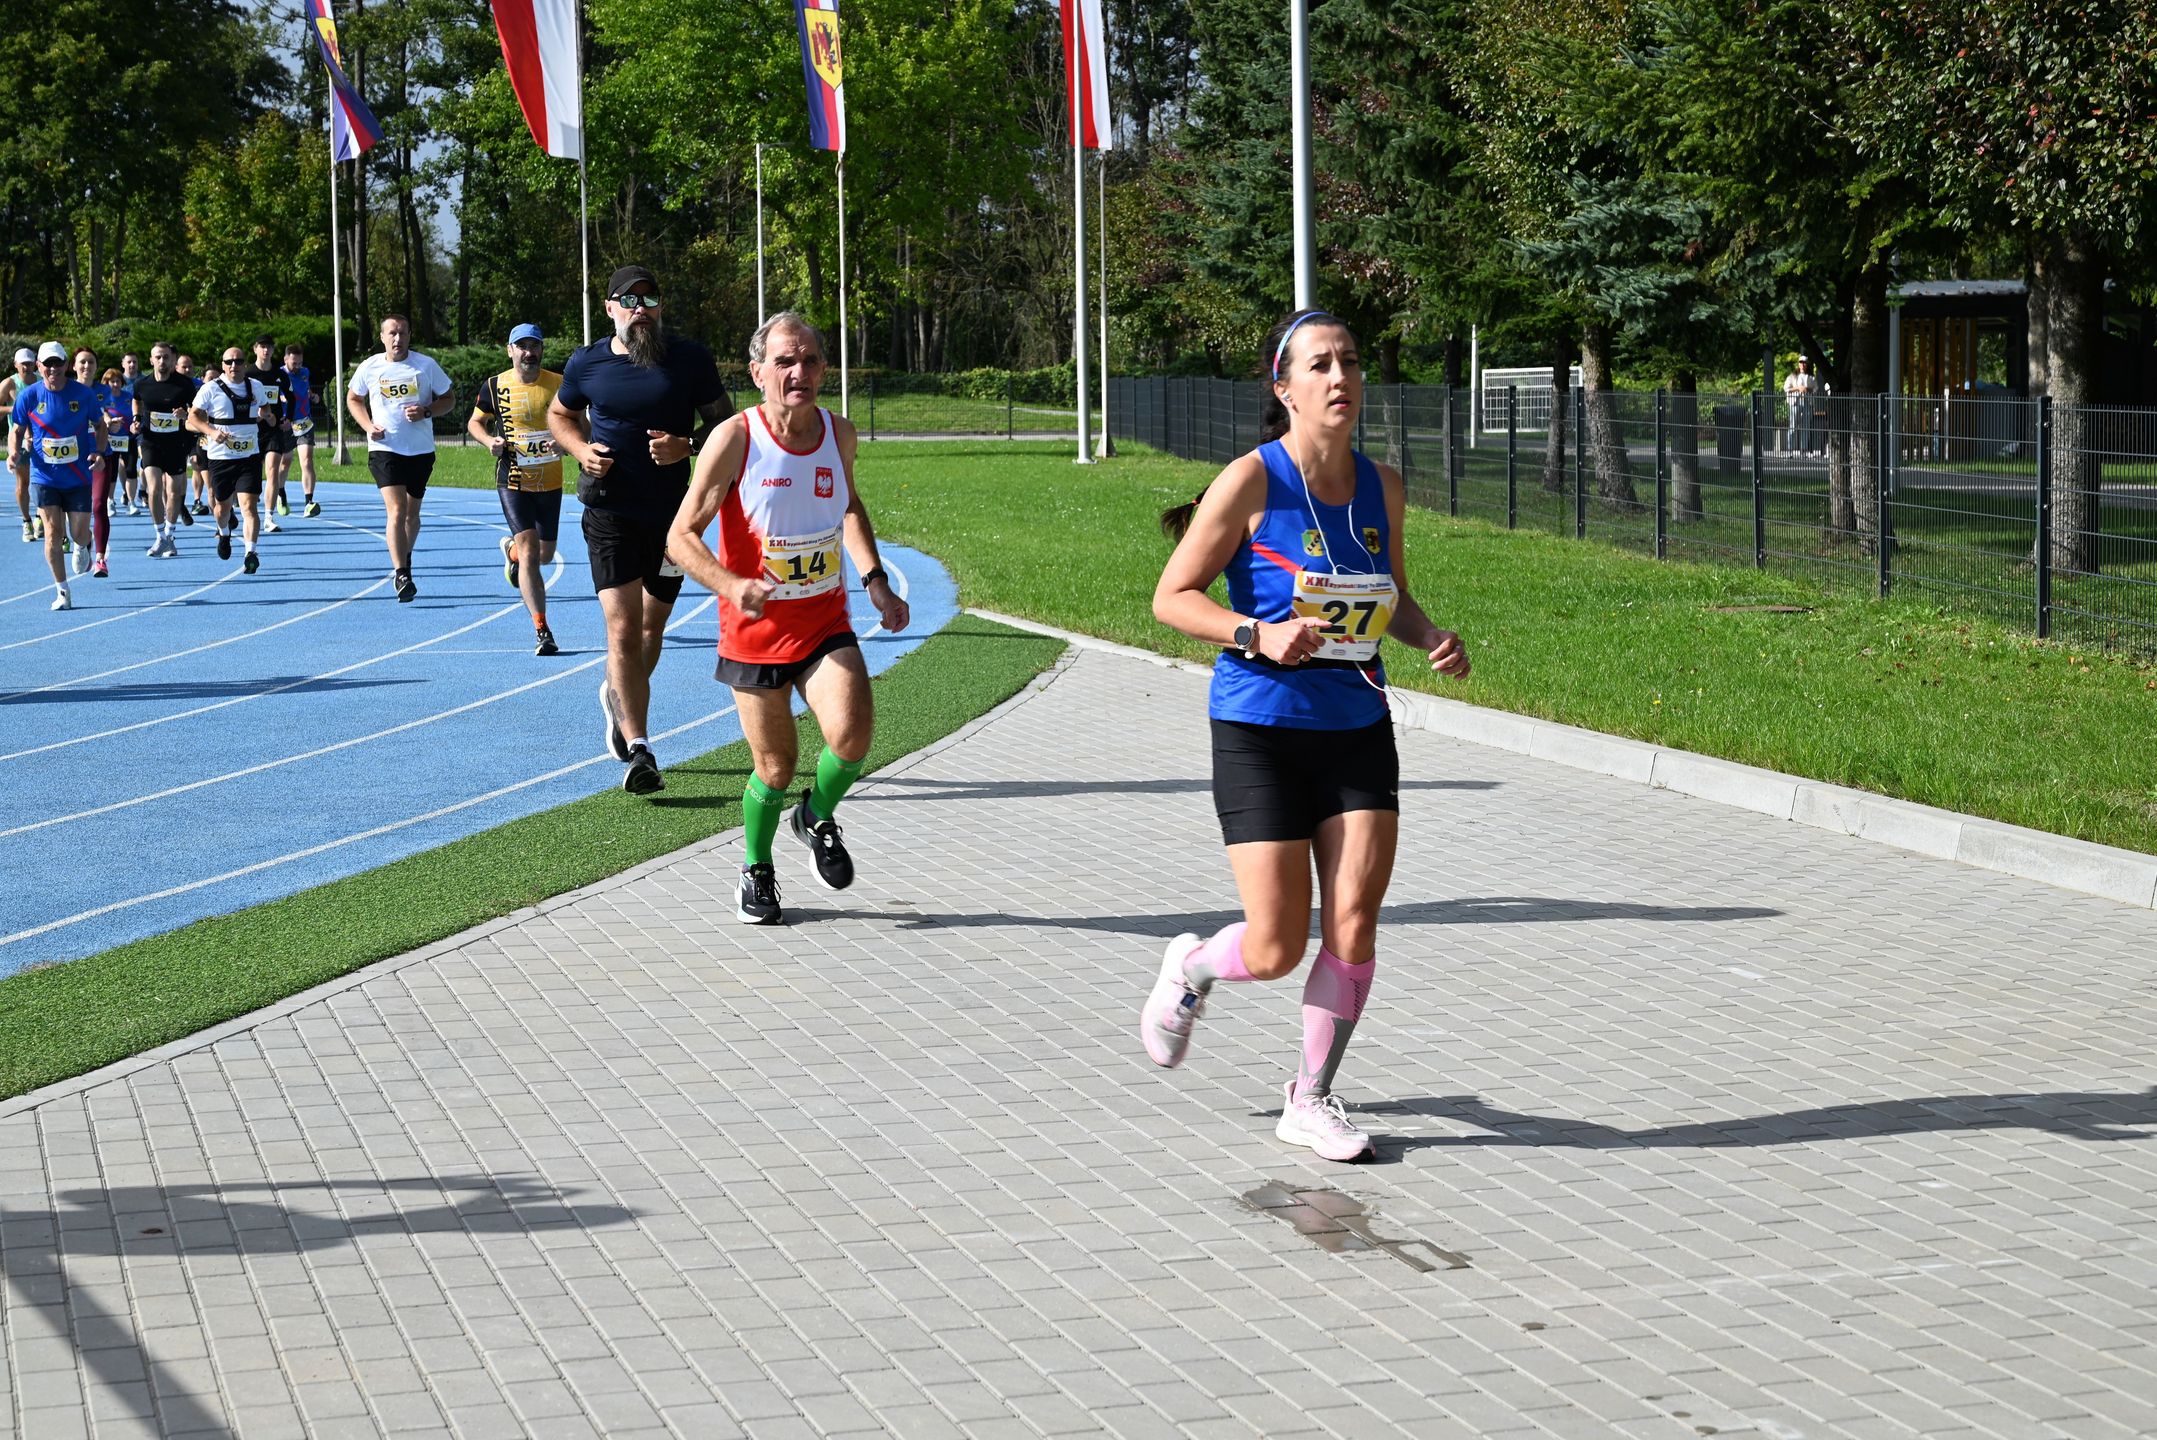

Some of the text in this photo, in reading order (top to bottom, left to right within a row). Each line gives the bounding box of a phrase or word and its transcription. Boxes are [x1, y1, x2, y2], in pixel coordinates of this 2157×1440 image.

[390, 384, 408, 396] 56
[157, 418, 172, 427] 72
[51, 445, 70, 457] 70
[233, 441, 249, 450] 63
[527, 440, 548, 455] 46
[761, 477, 792, 488] ANIRO
[788, 551, 827, 581] 14
[1305, 576, 1330, 588] XXI
[1318, 600, 1378, 636] 27
